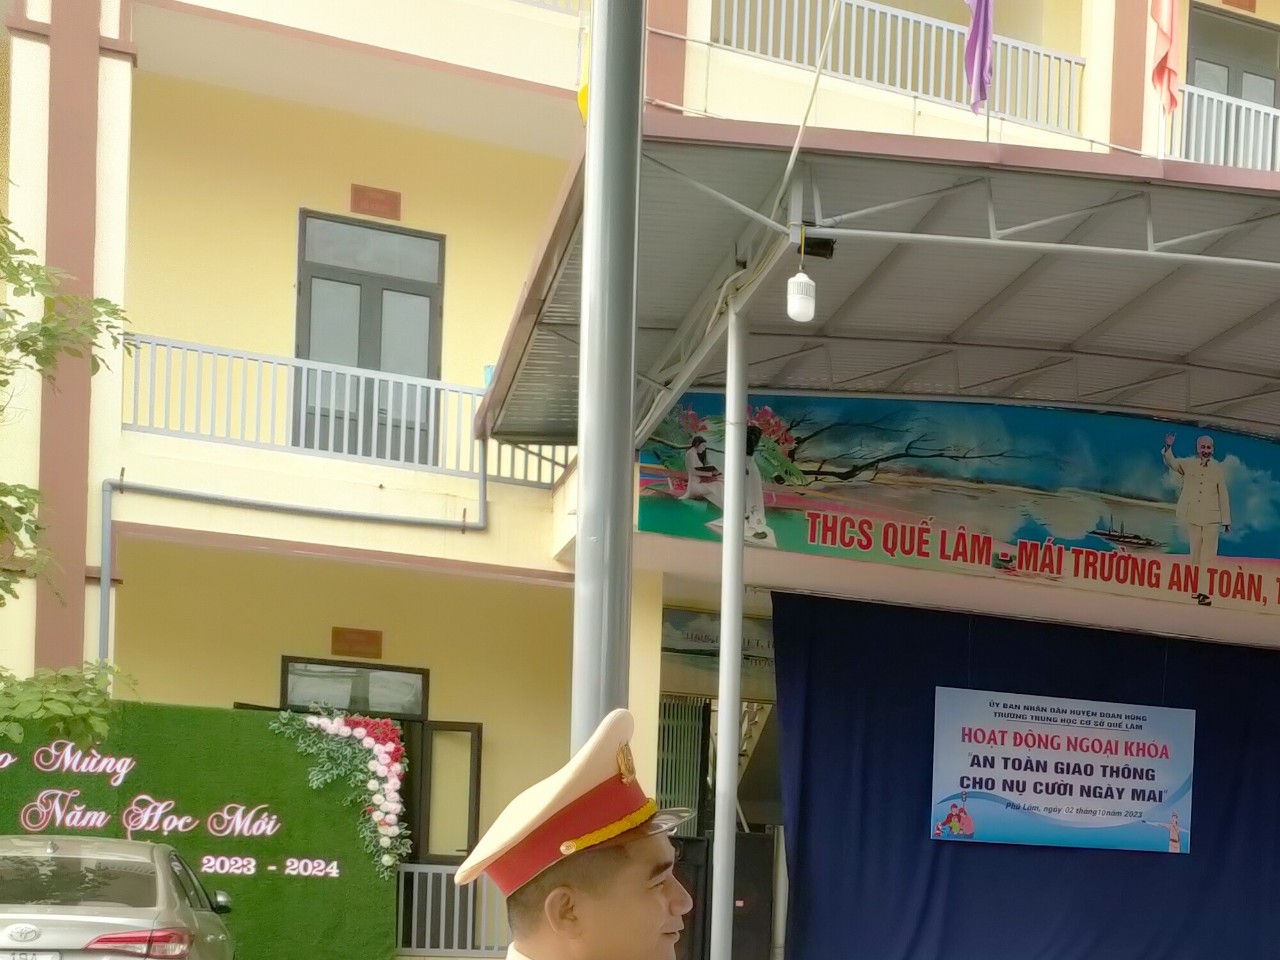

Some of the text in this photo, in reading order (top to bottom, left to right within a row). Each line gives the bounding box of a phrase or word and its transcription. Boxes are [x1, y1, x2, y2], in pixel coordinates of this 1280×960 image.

[806, 510, 873, 551] THCS
[882, 515, 936, 558] QUẾ
[939, 526, 993, 566] LÂM
[1016, 538, 1065, 576] MÁI
[1071, 546, 1161, 592] TRƯỜNG
[1168, 562, 1200, 594] AN
[1207, 565, 1268, 607] TOÀN,
[1003, 702, 1021, 710] BAN
[1030, 714, 1058, 723] TRUNG
[960, 726, 1170, 760] HOẠT ĐỘNG NGOẠI KHÓA
[34, 739, 137, 787] Mừng
[1001, 753, 1048, 773] TOÀN
[1054, 761, 1095, 777] GIAO
[1100, 763, 1156, 781] THÔNG
[959, 775, 996, 791] CHO
[1002, 779, 1027, 798] NỤ
[1032, 780, 1074, 797] CƯỜI
[1079, 784, 1126, 801] NGÀY
[21, 789, 281, 841] Năm Học Mới
[1043, 805, 1062, 815] ngày
[1064, 806, 1075, 814] 02
[1124, 810, 1143, 818] 2023
[201, 855, 256, 875] 2023
[285, 858, 340, 878] 2024
